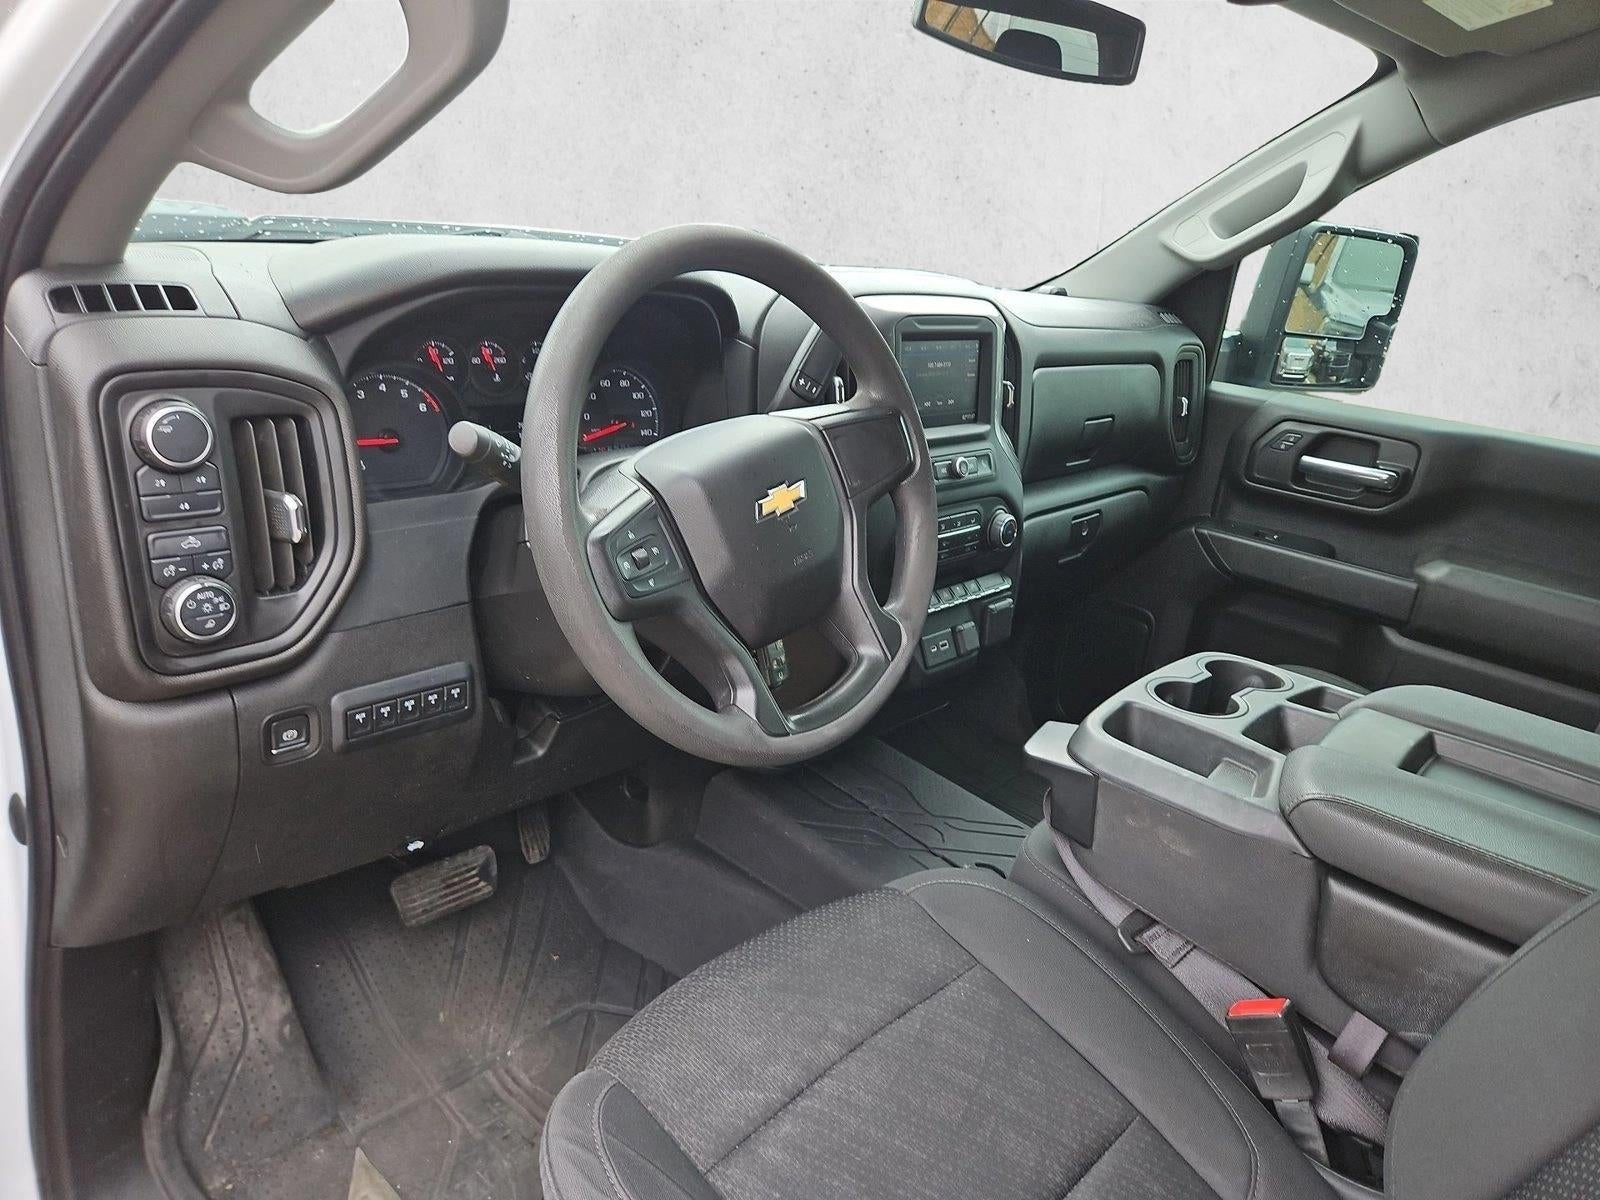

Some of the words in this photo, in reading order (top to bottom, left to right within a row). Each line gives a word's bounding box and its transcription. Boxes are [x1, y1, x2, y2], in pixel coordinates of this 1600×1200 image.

[379, 383, 387, 392] 4
[357, 389, 366, 400] 3
[400, 388, 409, 399] 5
[632, 391, 645, 400] 100
[418, 402, 427, 413] 6
[196, 590, 215, 600] AUTO
